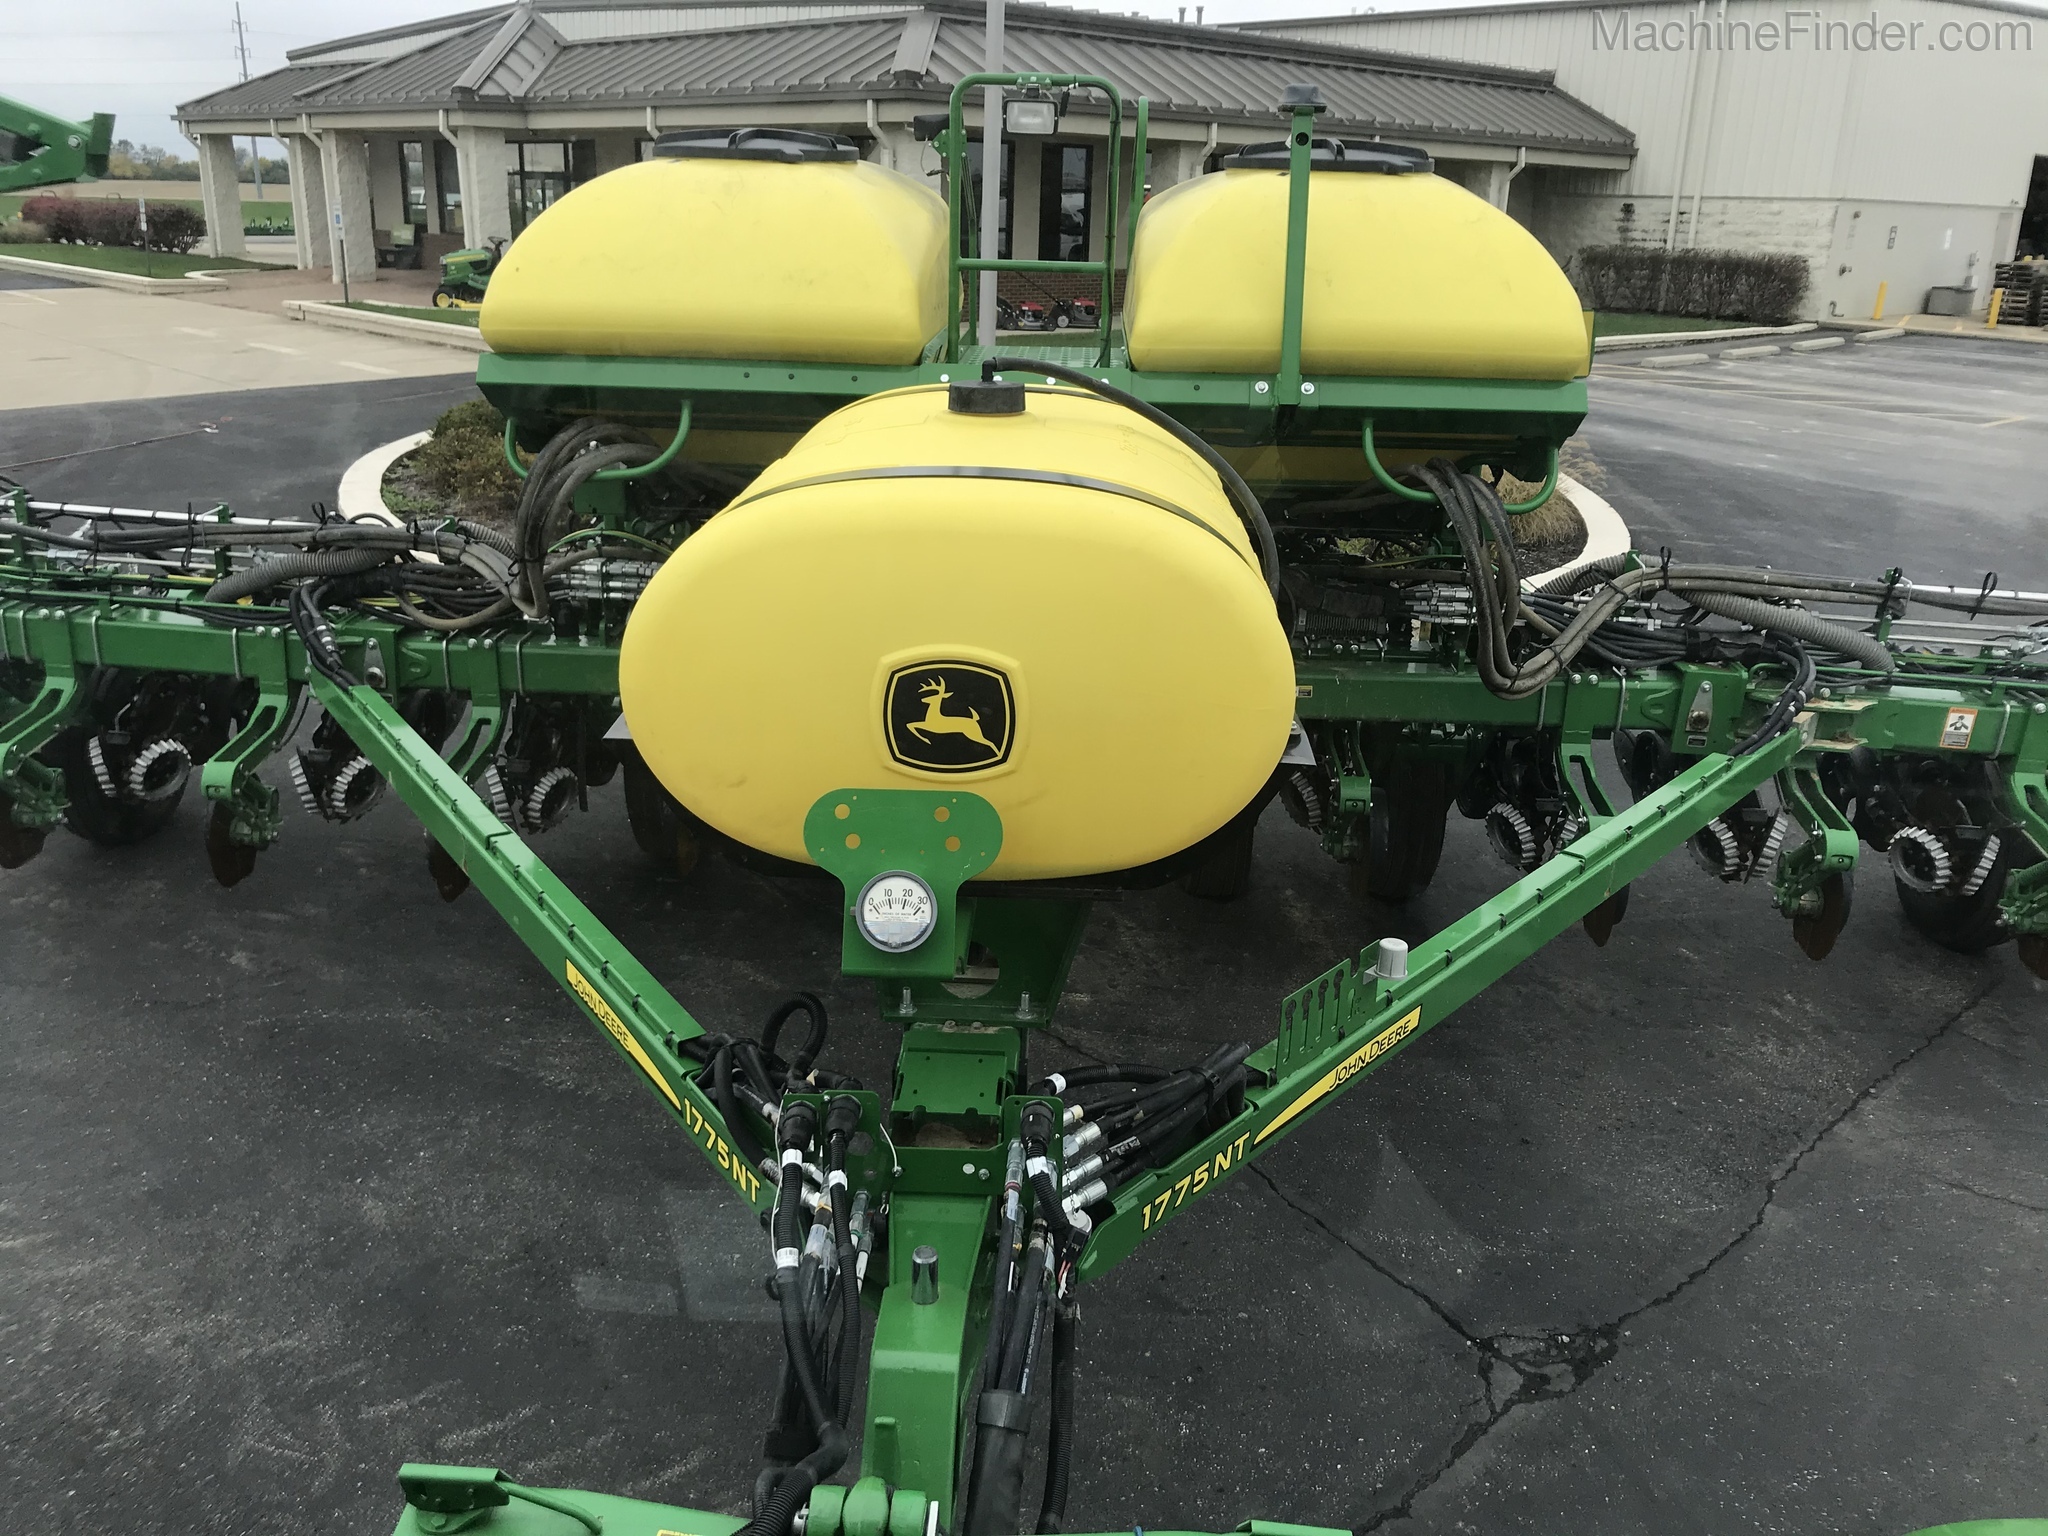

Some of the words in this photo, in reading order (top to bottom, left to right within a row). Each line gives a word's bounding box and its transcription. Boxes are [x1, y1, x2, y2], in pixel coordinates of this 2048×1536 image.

[868, 897, 874, 906] 0
[884, 888, 893, 897] 10
[902, 888, 913, 897] 20
[917, 896, 928, 905] 30
[572, 973, 598, 1014] JOHN
[598, 999, 630, 1049] DEERE
[1329, 1055, 1367, 1091] JOHN
[1368, 1018, 1412, 1062] DEERE
